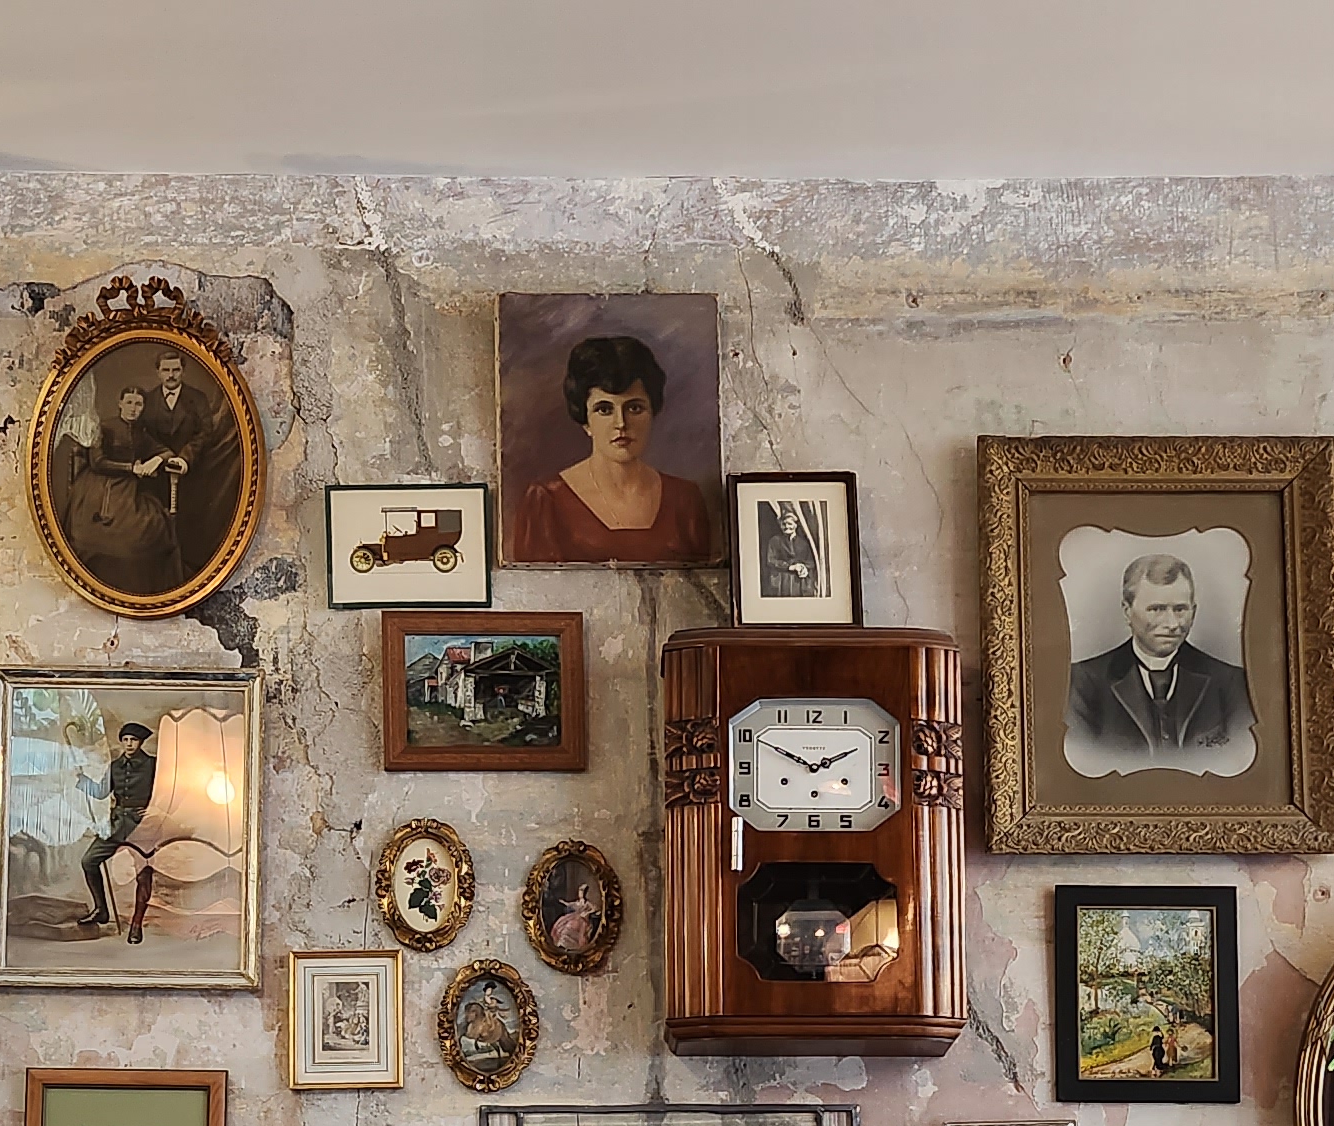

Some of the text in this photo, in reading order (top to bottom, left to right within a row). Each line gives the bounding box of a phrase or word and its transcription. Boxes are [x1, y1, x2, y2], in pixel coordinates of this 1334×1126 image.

[777, 709, 788, 724] 11
[806, 710, 823, 724] 12
[843, 710, 848, 724] 1
[738, 729, 753, 743] 10
[878, 730, 890, 745] 2
[739, 761, 751, 775] 9
[878, 763, 890, 777] 3
[739, 794, 751, 807] 8
[877, 795, 890, 810] 4
[776, 814, 789, 828] 7
[807, 814, 820, 828] 6
[840, 814, 852, 828] 5
